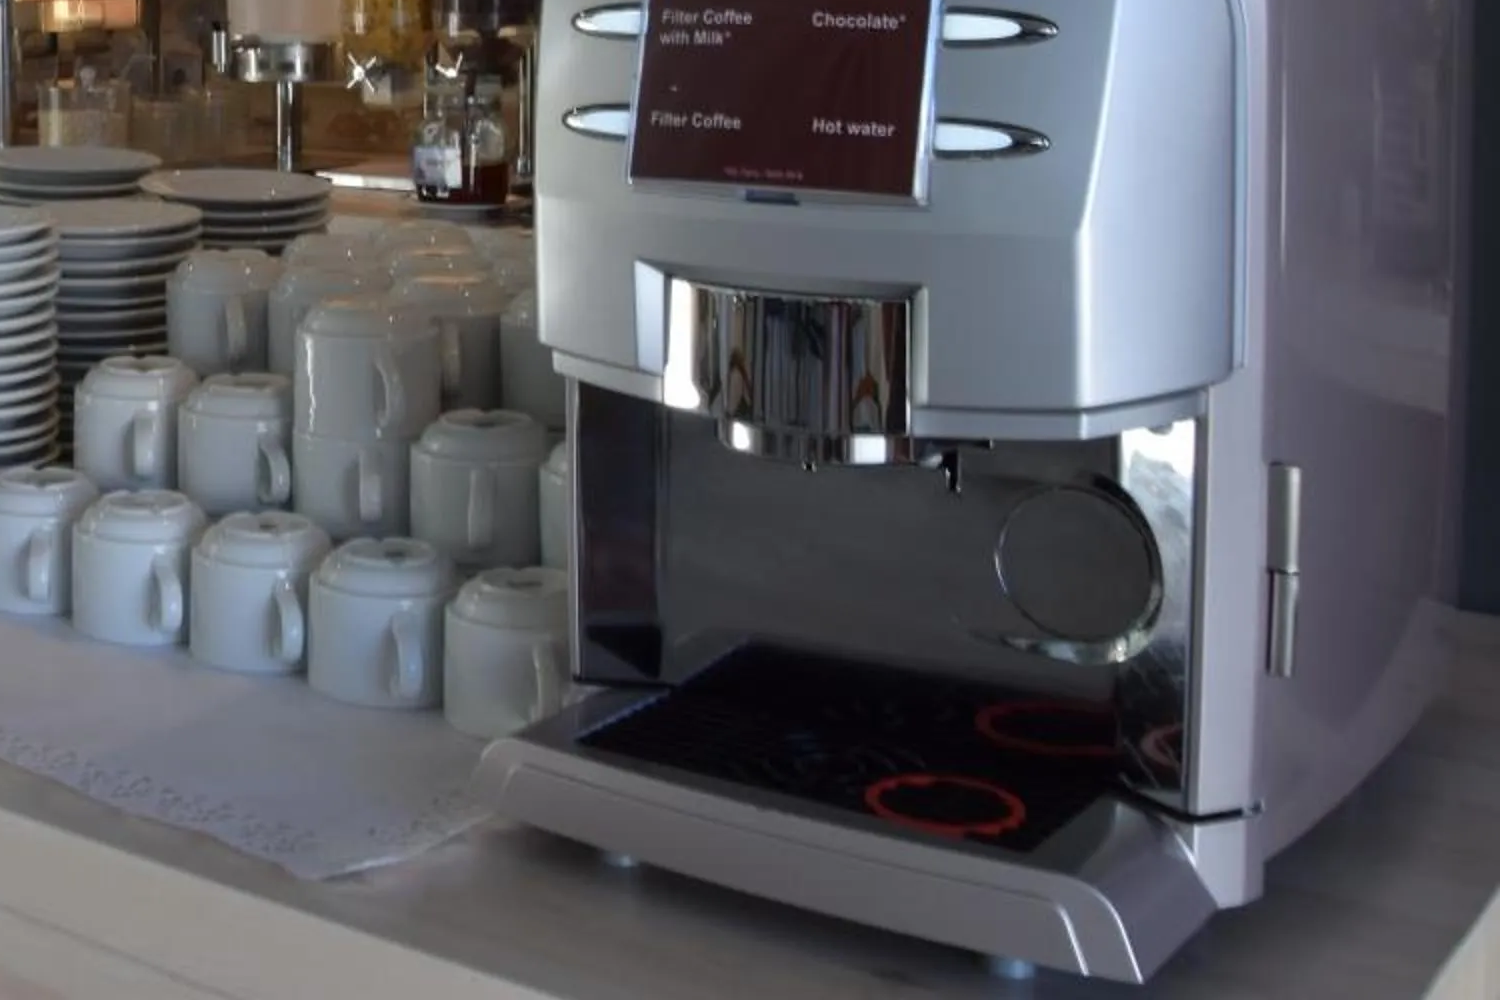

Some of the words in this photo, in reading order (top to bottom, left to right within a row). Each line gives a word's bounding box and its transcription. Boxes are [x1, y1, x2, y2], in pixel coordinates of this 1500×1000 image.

[662, 8, 699, 25] Filter
[703, 8, 753, 26] Coffee
[660, 30, 690, 45] with
[650, 110, 688, 127] Filter
[691, 111, 742, 130] Coffee
[812, 117, 842, 136] Hot
[846, 121, 895, 138] water
